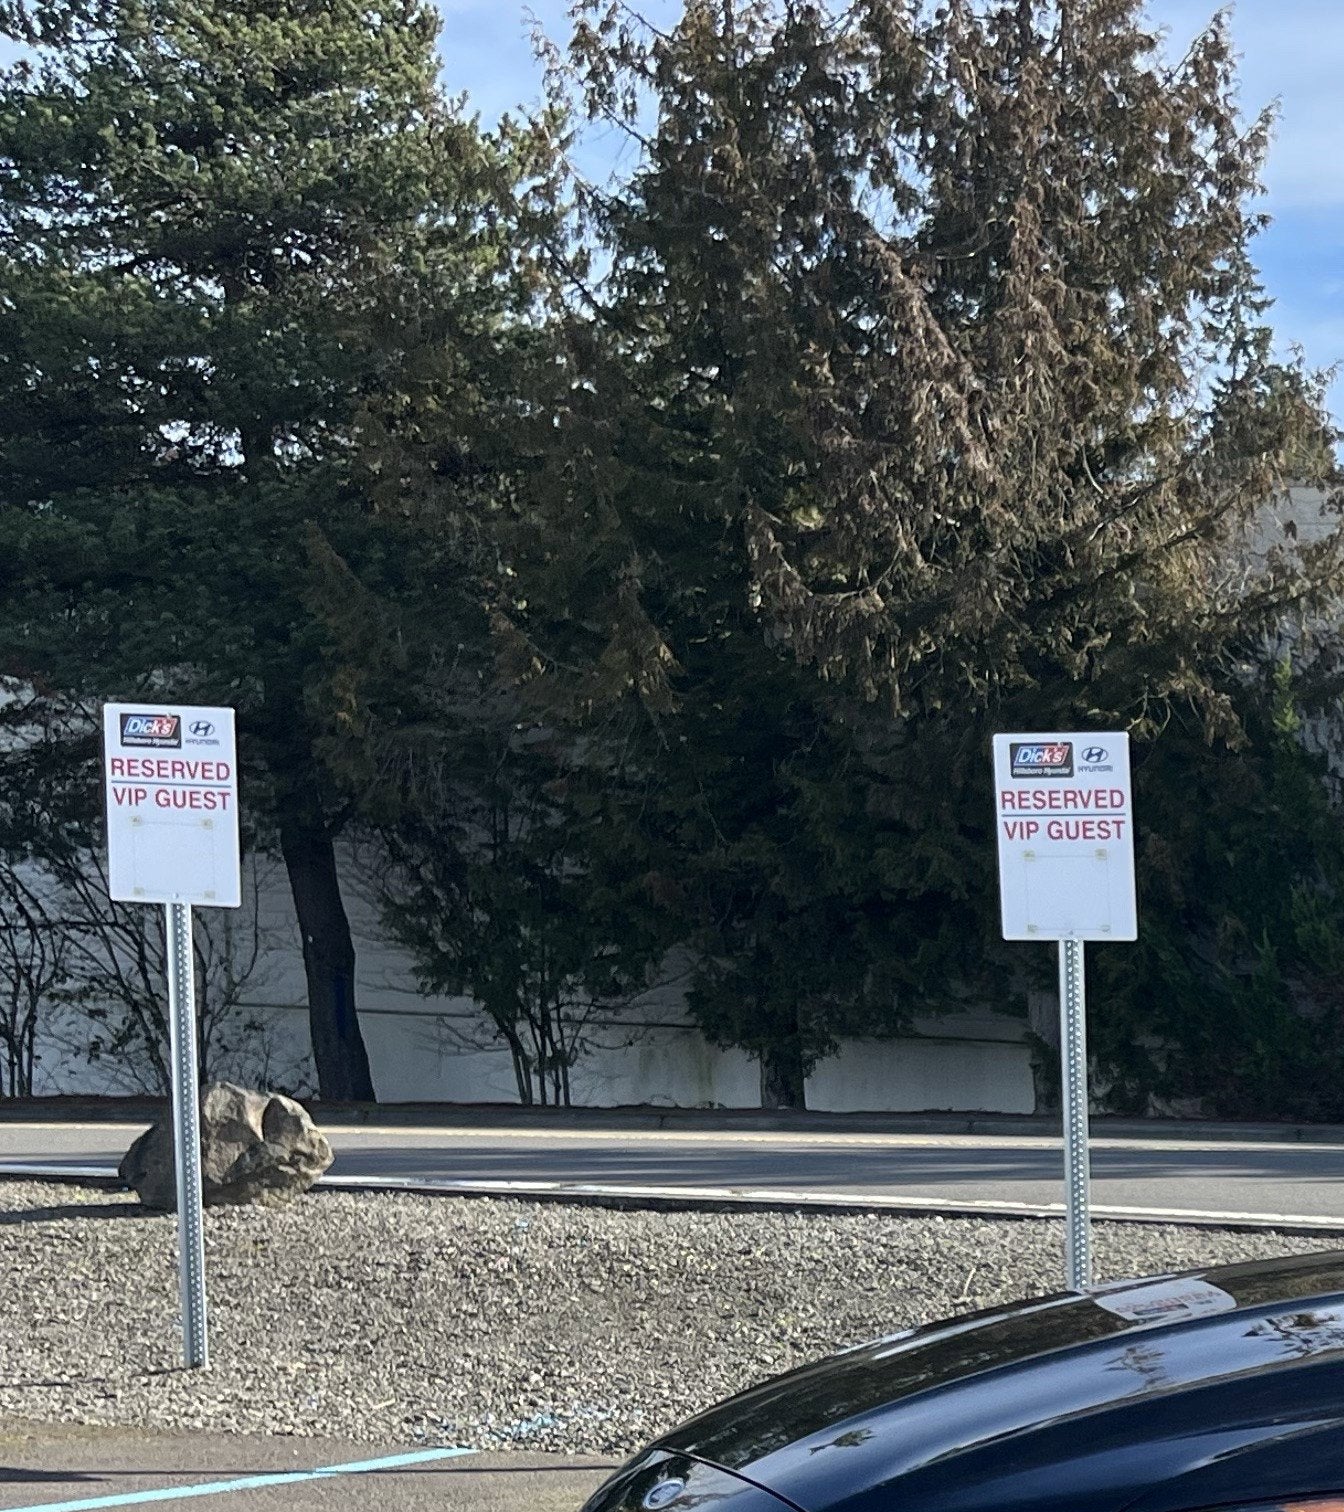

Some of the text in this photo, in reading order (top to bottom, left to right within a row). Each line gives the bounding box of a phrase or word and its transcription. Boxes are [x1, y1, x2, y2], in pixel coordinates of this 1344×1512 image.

[111, 758, 230, 781] RESERVED
[113, 787, 231, 811] VIP GUEST
[1001, 789, 1125, 810] RESERVED
[1004, 820, 1125, 840] VIP GUEST
